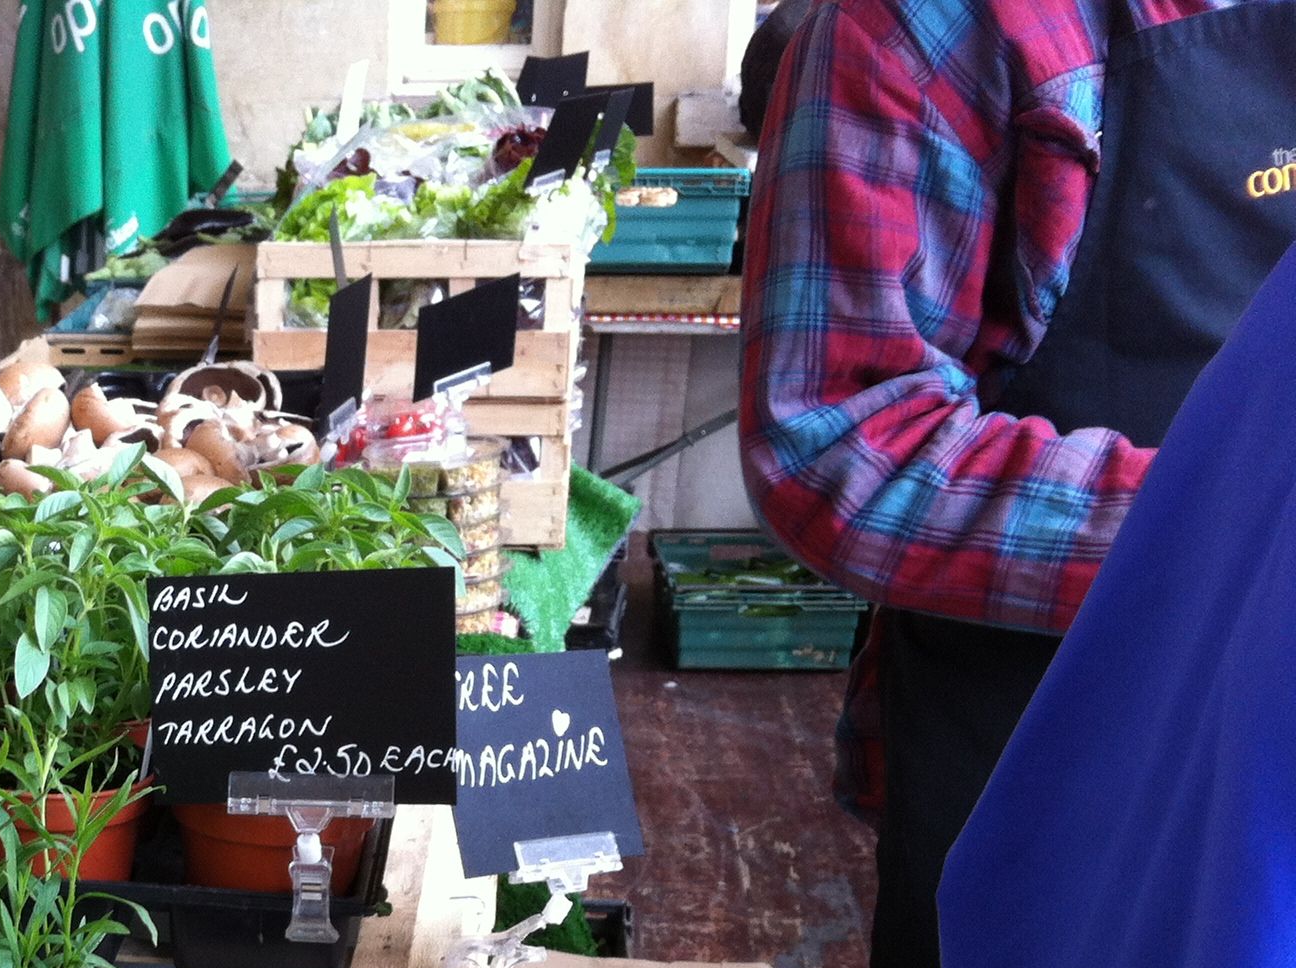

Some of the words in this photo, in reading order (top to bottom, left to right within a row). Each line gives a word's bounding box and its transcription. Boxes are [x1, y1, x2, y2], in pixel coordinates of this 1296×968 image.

[153, 584, 248, 612] BASIL
[153, 619, 350, 652] CORIANDER
[154, 667, 302, 704] PARSLEY
[455, 662, 525, 712] REE
[158, 714, 333, 746] TARRAGON
[380, 745, 457, 774] EACH
[454, 726, 608, 788] MAGAZINE
